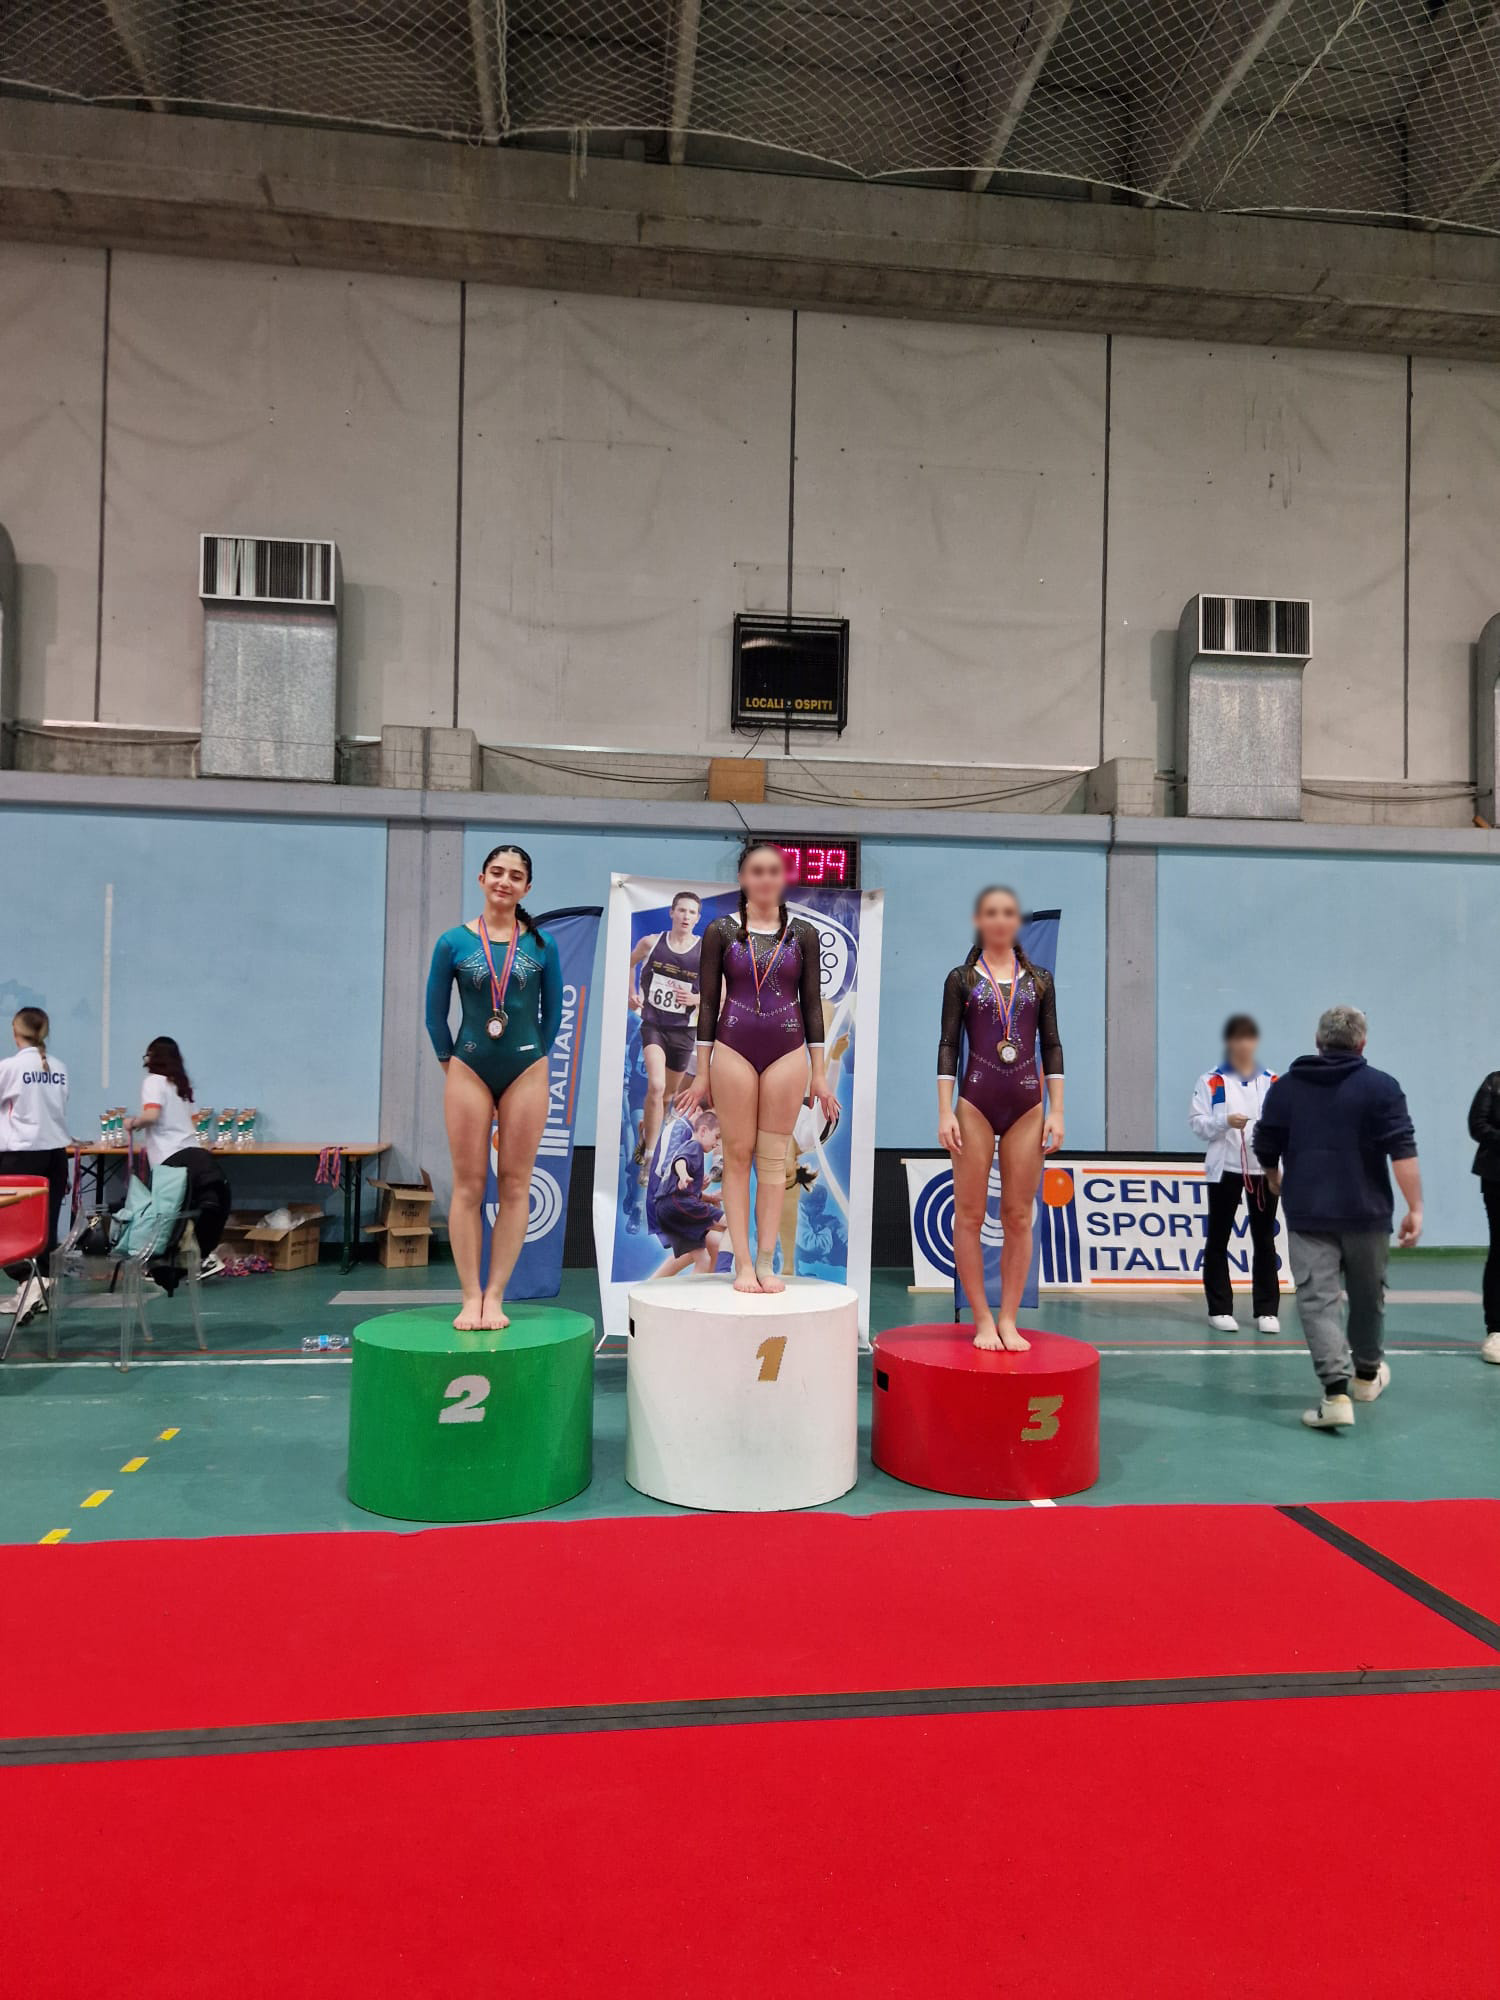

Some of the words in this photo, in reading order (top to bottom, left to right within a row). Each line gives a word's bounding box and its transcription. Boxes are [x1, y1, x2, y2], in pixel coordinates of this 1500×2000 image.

[745, 697, 784, 709] LOCALI
[794, 699, 833, 711] OSPITI
[653, 988, 682, 1009] 68
[547, 984, 578, 1125] ITALIANO
[22, 1071, 66, 1085] GIUDICE
[1083, 1179, 1243, 1204] CENT
[756, 1335, 788, 1382] 1
[438, 1374, 491, 1424] 2
[1020, 1394, 1064, 1442] 3
